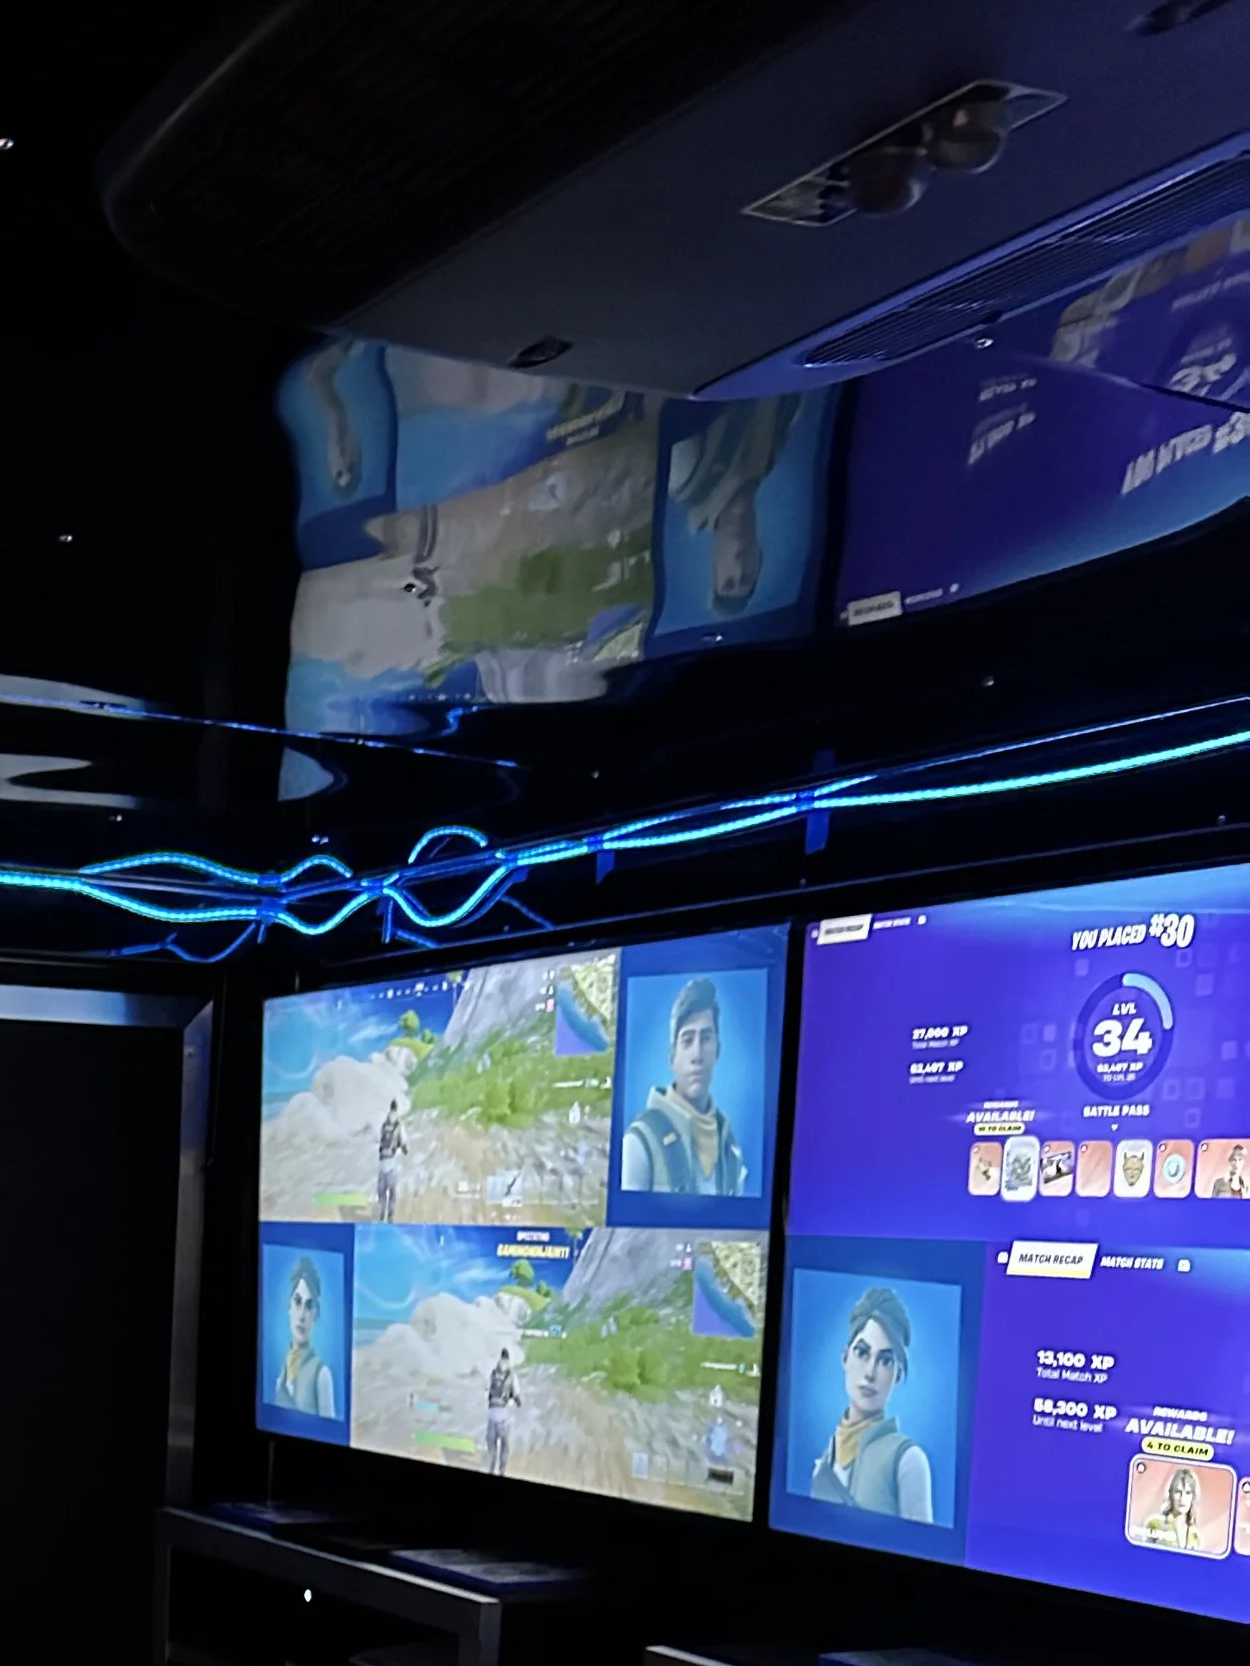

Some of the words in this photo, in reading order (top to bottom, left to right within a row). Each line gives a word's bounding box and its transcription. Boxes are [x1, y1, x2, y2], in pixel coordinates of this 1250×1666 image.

[1097, 923, 1147, 949] PLACED
[1149, 912, 1195, 948] #30
[1112, 1002, 1138, 1016] LVL
[1092, 1017, 1153, 1058] 34
[1083, 1105, 1120, 1118] BATTLE
[1121, 1104, 1150, 1117] PASS
[1018, 1253, 1052, 1265] MATCH
[1052, 1254, 1084, 1265] RECAP
[1100, 1255, 1132, 1269] MATCH
[1090, 1354, 1115, 1370] XP
[1093, 1404, 1117, 1420] XP
[1124, 1418, 1235, 1445] AVAILABLE!
[1157, 1443, 1171, 1452] TO
[1173, 1444, 1209, 1456] CLAIM
